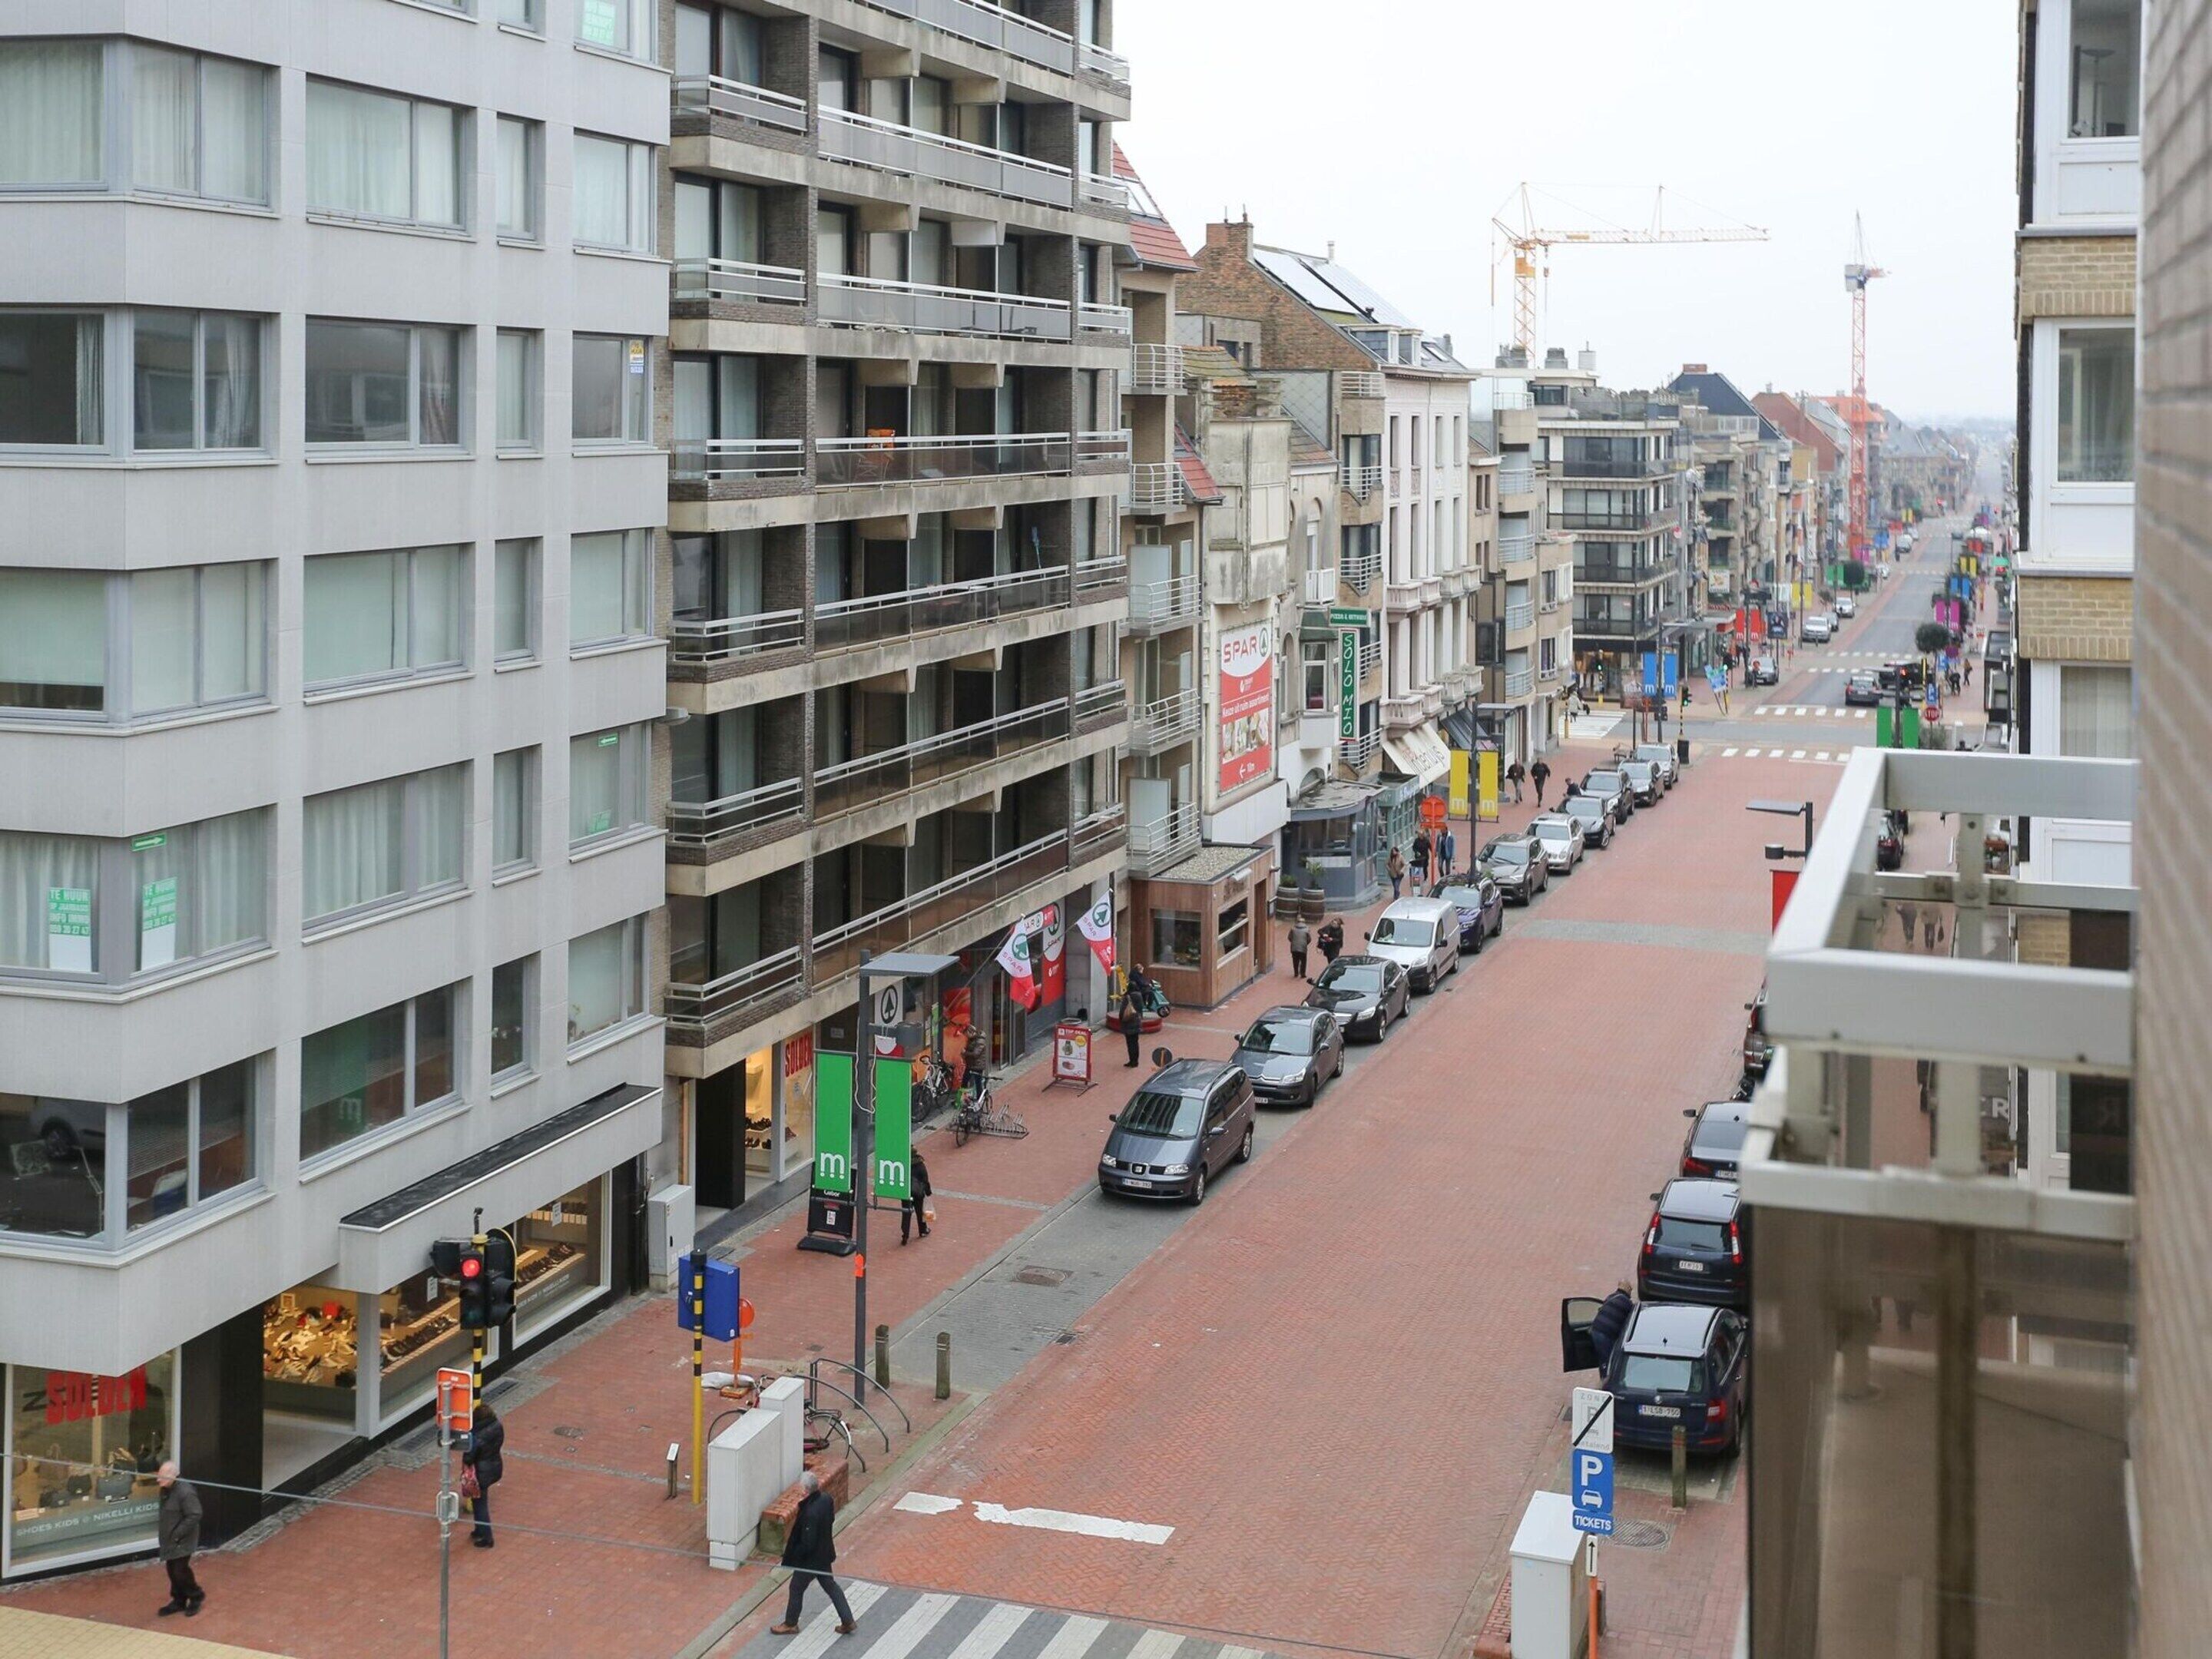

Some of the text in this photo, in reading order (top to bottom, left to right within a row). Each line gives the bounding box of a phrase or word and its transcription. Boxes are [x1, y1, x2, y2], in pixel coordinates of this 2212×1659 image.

[1223, 635, 1258, 664] SPAR
[1343, 634, 1354, 734] SOLO MIO
[1452, 798, 1465, 812] m
[1482, 799, 1494, 813] m
[50, 889, 88, 902] TE HUUR
[1083, 917, 1097, 936] SPAR
[1002, 952, 1023, 972] SPAR
[786, 1032, 813, 1078] SOLDEN
[820, 1152, 845, 1179] m
[879, 1159, 905, 1186] m
[46, 1363, 147, 1426] SOLDEN
[1578, 1441, 1611, 1451] etalend
[1581, 1455, 1604, 1486] P
[17, 1524, 52, 1537] SHOES
[54, 1518, 80, 1529] KIDS
[93, 1508, 133, 1522] NIKELLI
[135, 1502, 160, 1512] KIDS
[1575, 1515, 1612, 1531] TICKETS
